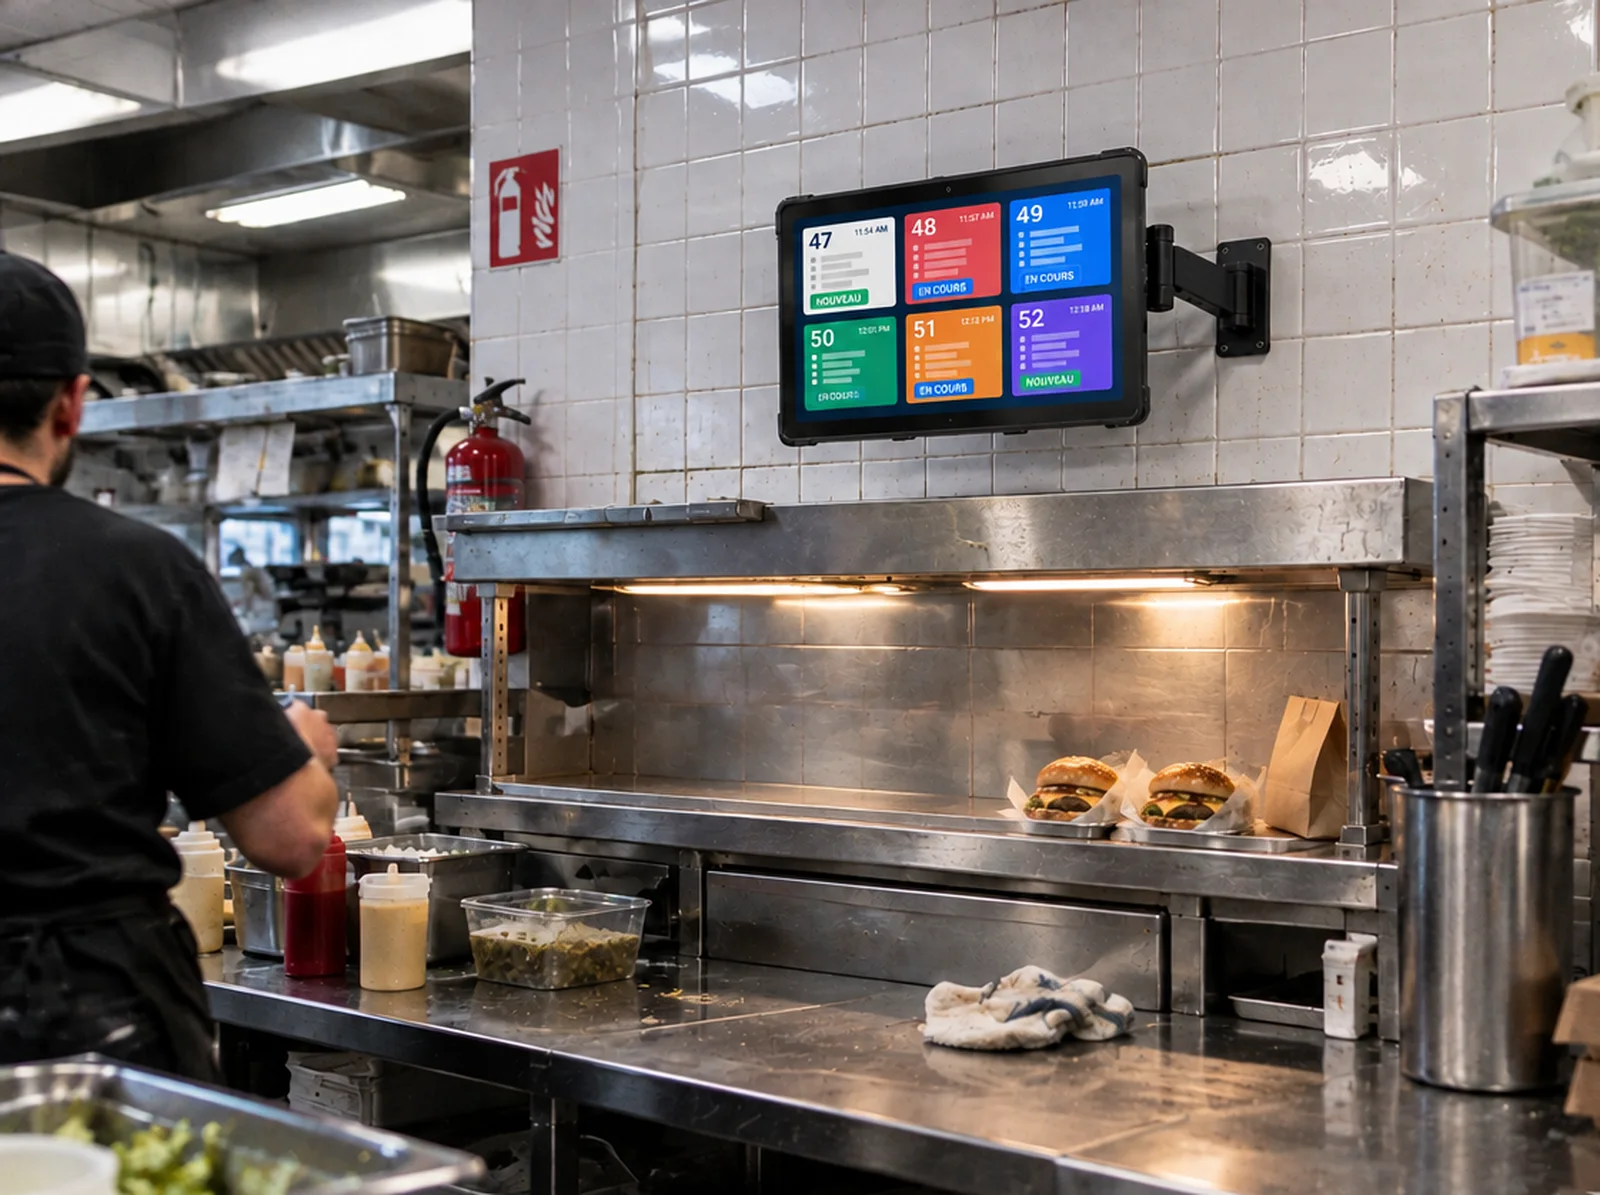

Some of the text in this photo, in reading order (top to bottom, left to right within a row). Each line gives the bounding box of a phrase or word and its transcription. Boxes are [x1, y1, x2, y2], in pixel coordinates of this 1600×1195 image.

[1089, 197, 1104, 206] AM
[980, 211, 995, 220] AM
[1016, 204, 1043, 224] 49
[875, 224, 889, 233] AM
[911, 217, 937, 237] 48
[808, 231, 833, 250] 47
[1024, 270, 1075, 285] EN COURS
[918, 286, 931, 297] EN
[815, 293, 862, 306] NOUVEAU
[1091, 303, 1104, 312] AM
[1018, 308, 1045, 329] 52
[878, 325, 891, 333] PM
[913, 319, 935, 338] 51
[811, 328, 835, 348] 50
[1025, 374, 1075, 388] NOUVEAU
